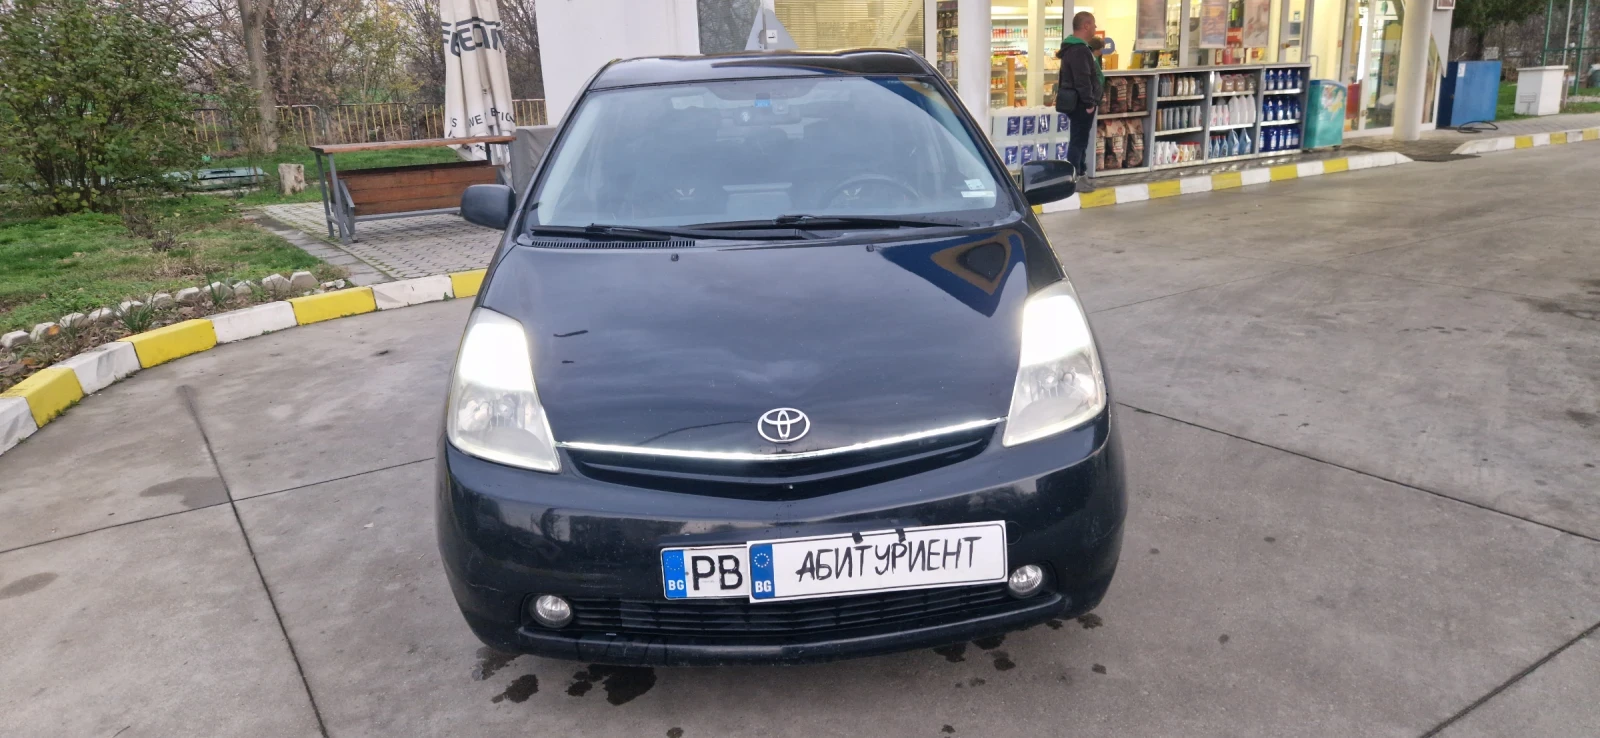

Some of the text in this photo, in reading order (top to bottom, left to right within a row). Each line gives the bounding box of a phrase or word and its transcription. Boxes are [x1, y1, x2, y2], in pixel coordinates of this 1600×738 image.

[668, 554, 743, 591] BG PB
[795, 536, 982, 583] АБИТУРИЕНТ
[755, 580, 772, 593] BG
